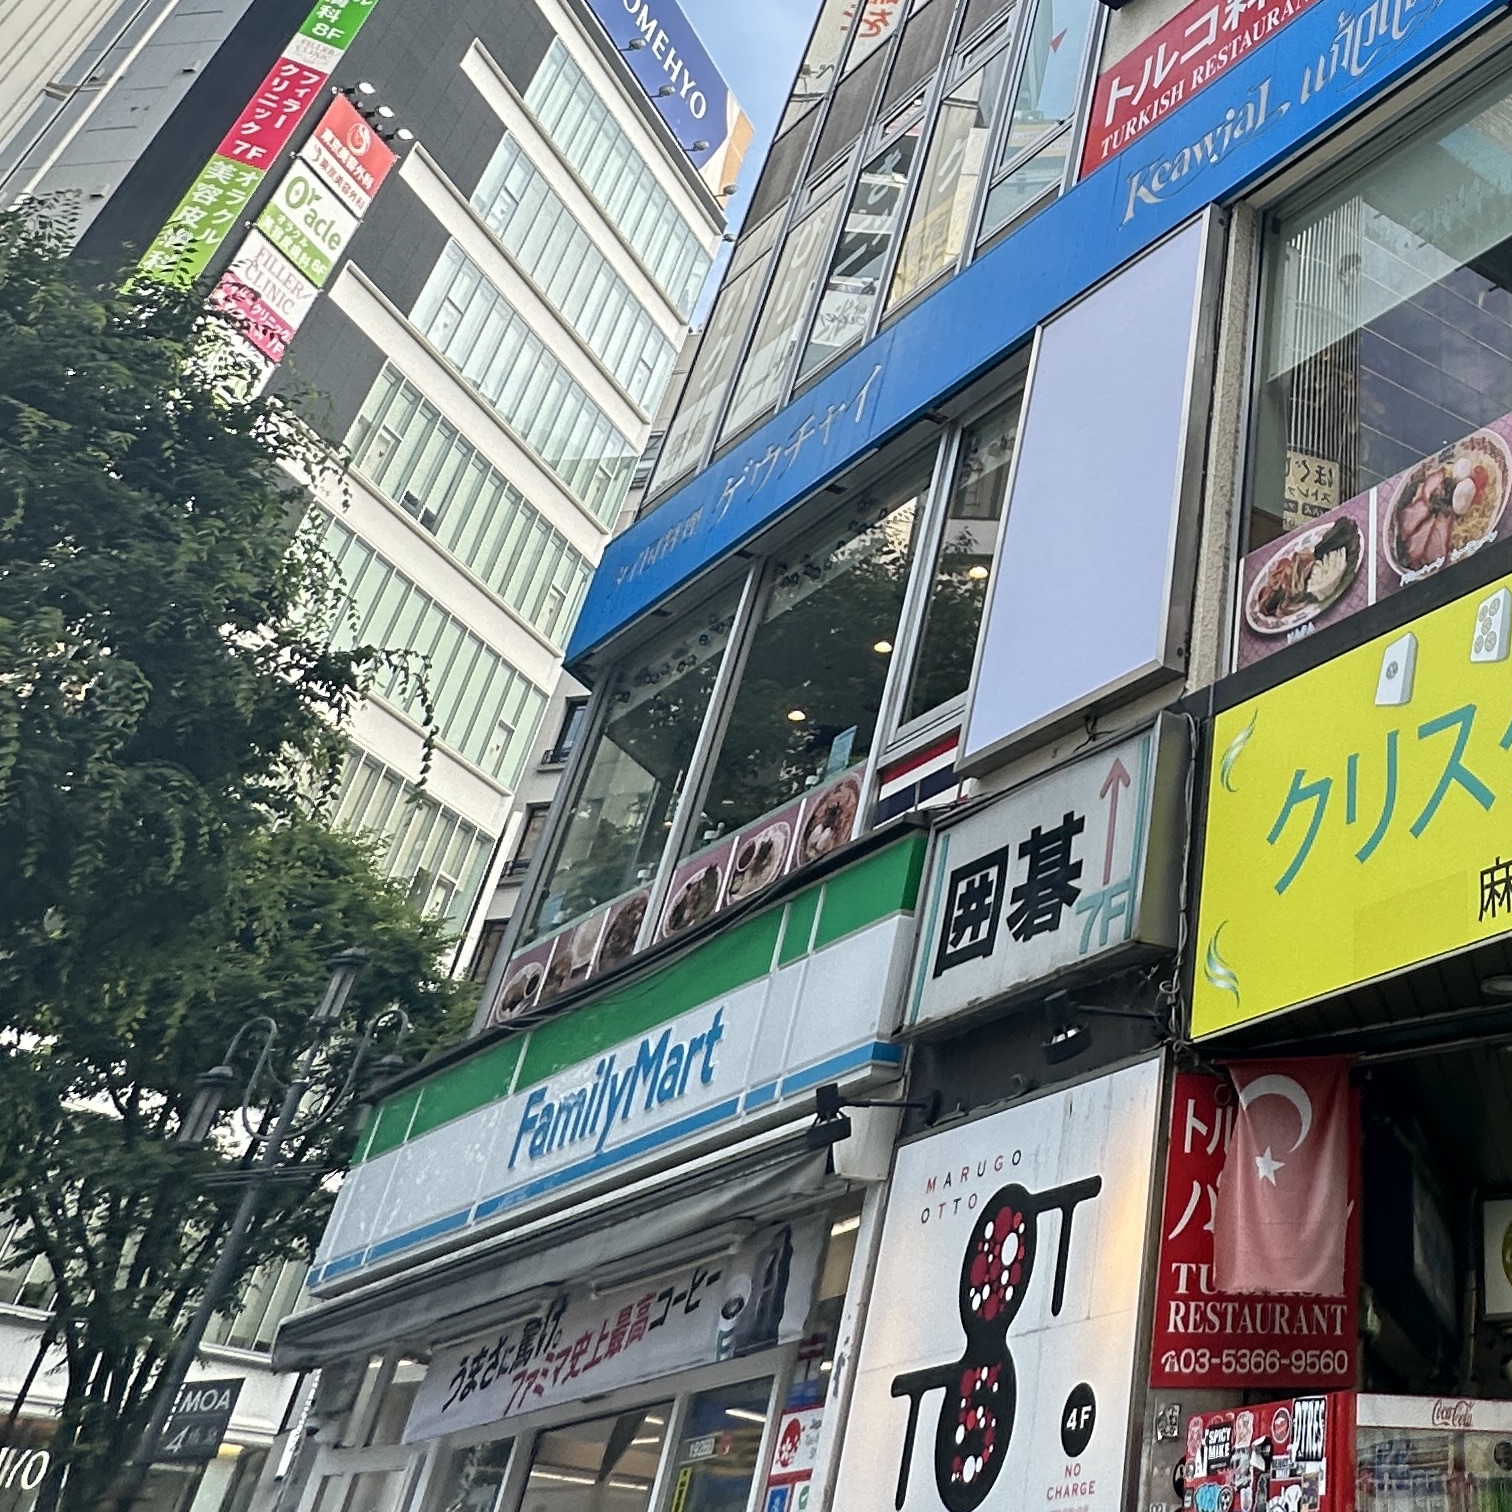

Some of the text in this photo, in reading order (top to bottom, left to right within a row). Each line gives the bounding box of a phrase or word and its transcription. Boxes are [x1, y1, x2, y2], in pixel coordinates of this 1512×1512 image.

[312, 22, 345, 40] 8F
[241, 63, 299, 135] クリニック
[275, 70, 320, 129] フィラー
[1101, 86, 1183, 158] TURKISH
[232, 140, 267, 160] 7F
[200, 169, 259, 245] オラクル
[710, 364, 882, 527] ゲウチャイ
[933, 811, 1085, 979] 囲碁
[508, 1005, 725, 1170] FamilyMart
[925, 1149, 1022, 1195] MARUGO
[920, 1192, 979, 1224] OTTO
[1168, 1300, 1348, 1335] RESTAURANT
[1180, 1349, 1349, 1376] 03-5366-9560
[179, 1389, 231, 1414] MOA
[1066, 1407, 1093, 1432] 4F
[1065, 1463, 1082, 1478] NO
[1046, 1480, 1096, 1500] CHARGE
